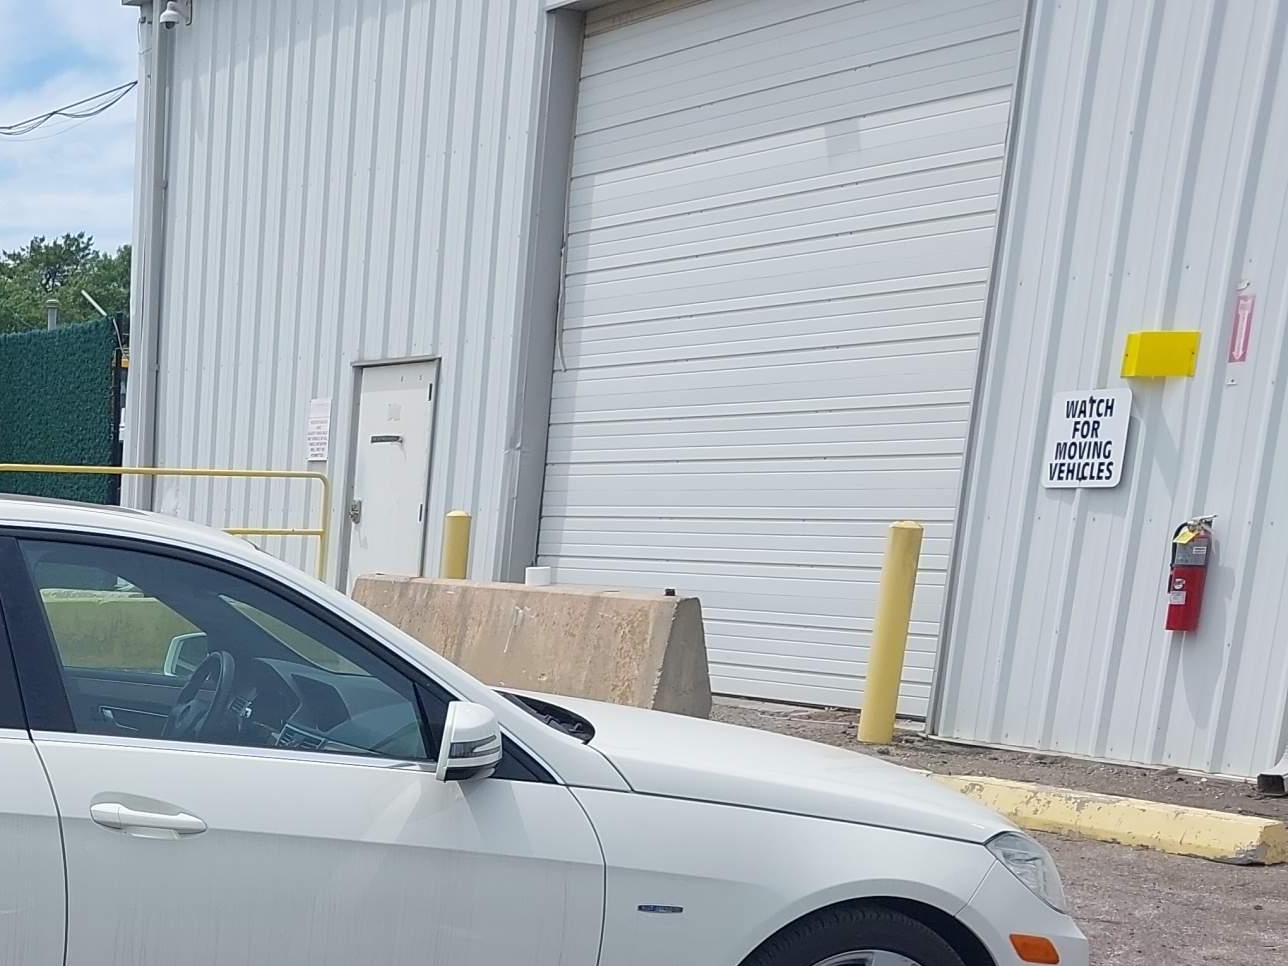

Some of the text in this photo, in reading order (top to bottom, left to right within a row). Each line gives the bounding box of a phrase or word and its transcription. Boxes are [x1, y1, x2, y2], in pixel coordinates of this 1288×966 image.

[1065, 397, 1115, 419] WATCH
[1072, 420, 1100, 439] FOR
[1054, 440, 1113, 461] MOVING
[1048, 461, 1114, 482] VEHICLES
